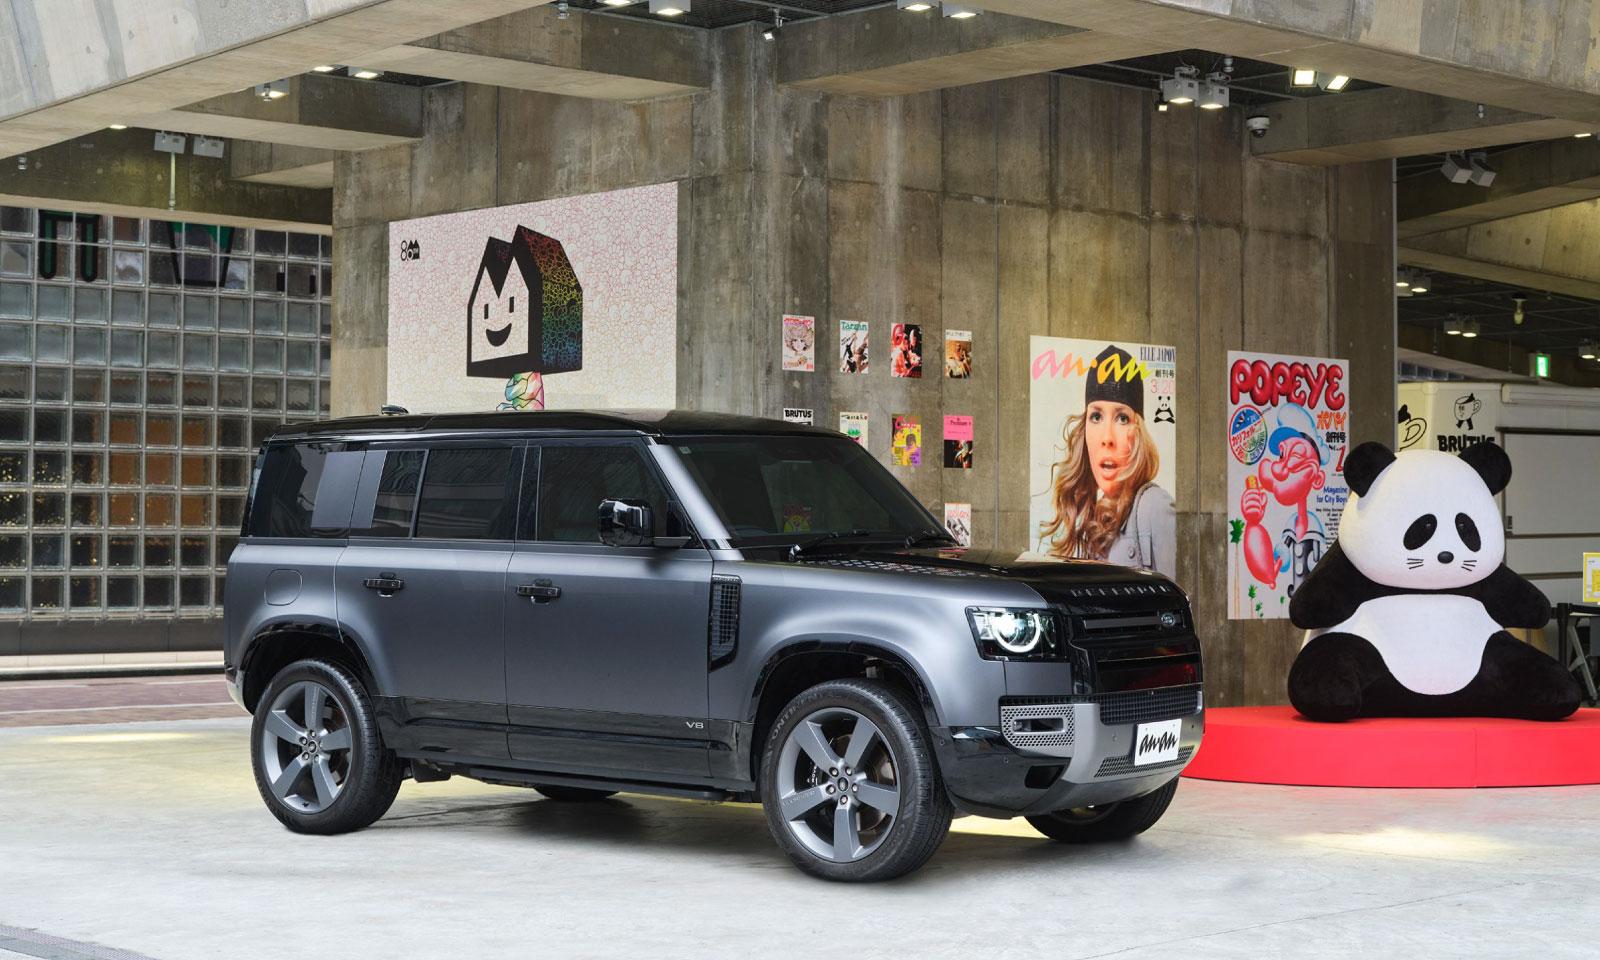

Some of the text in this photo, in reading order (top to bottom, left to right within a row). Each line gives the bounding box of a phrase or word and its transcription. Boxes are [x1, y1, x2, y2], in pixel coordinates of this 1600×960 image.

[1140, 346, 1155, 362] ELLE
[1230, 359, 1345, 411] POPEYE
[785, 409, 812, 418] BRUTUS
[1323, 486, 1347, 495] Magazine
[1324, 495, 1335, 505] City
[685, 721, 704, 729] V8
